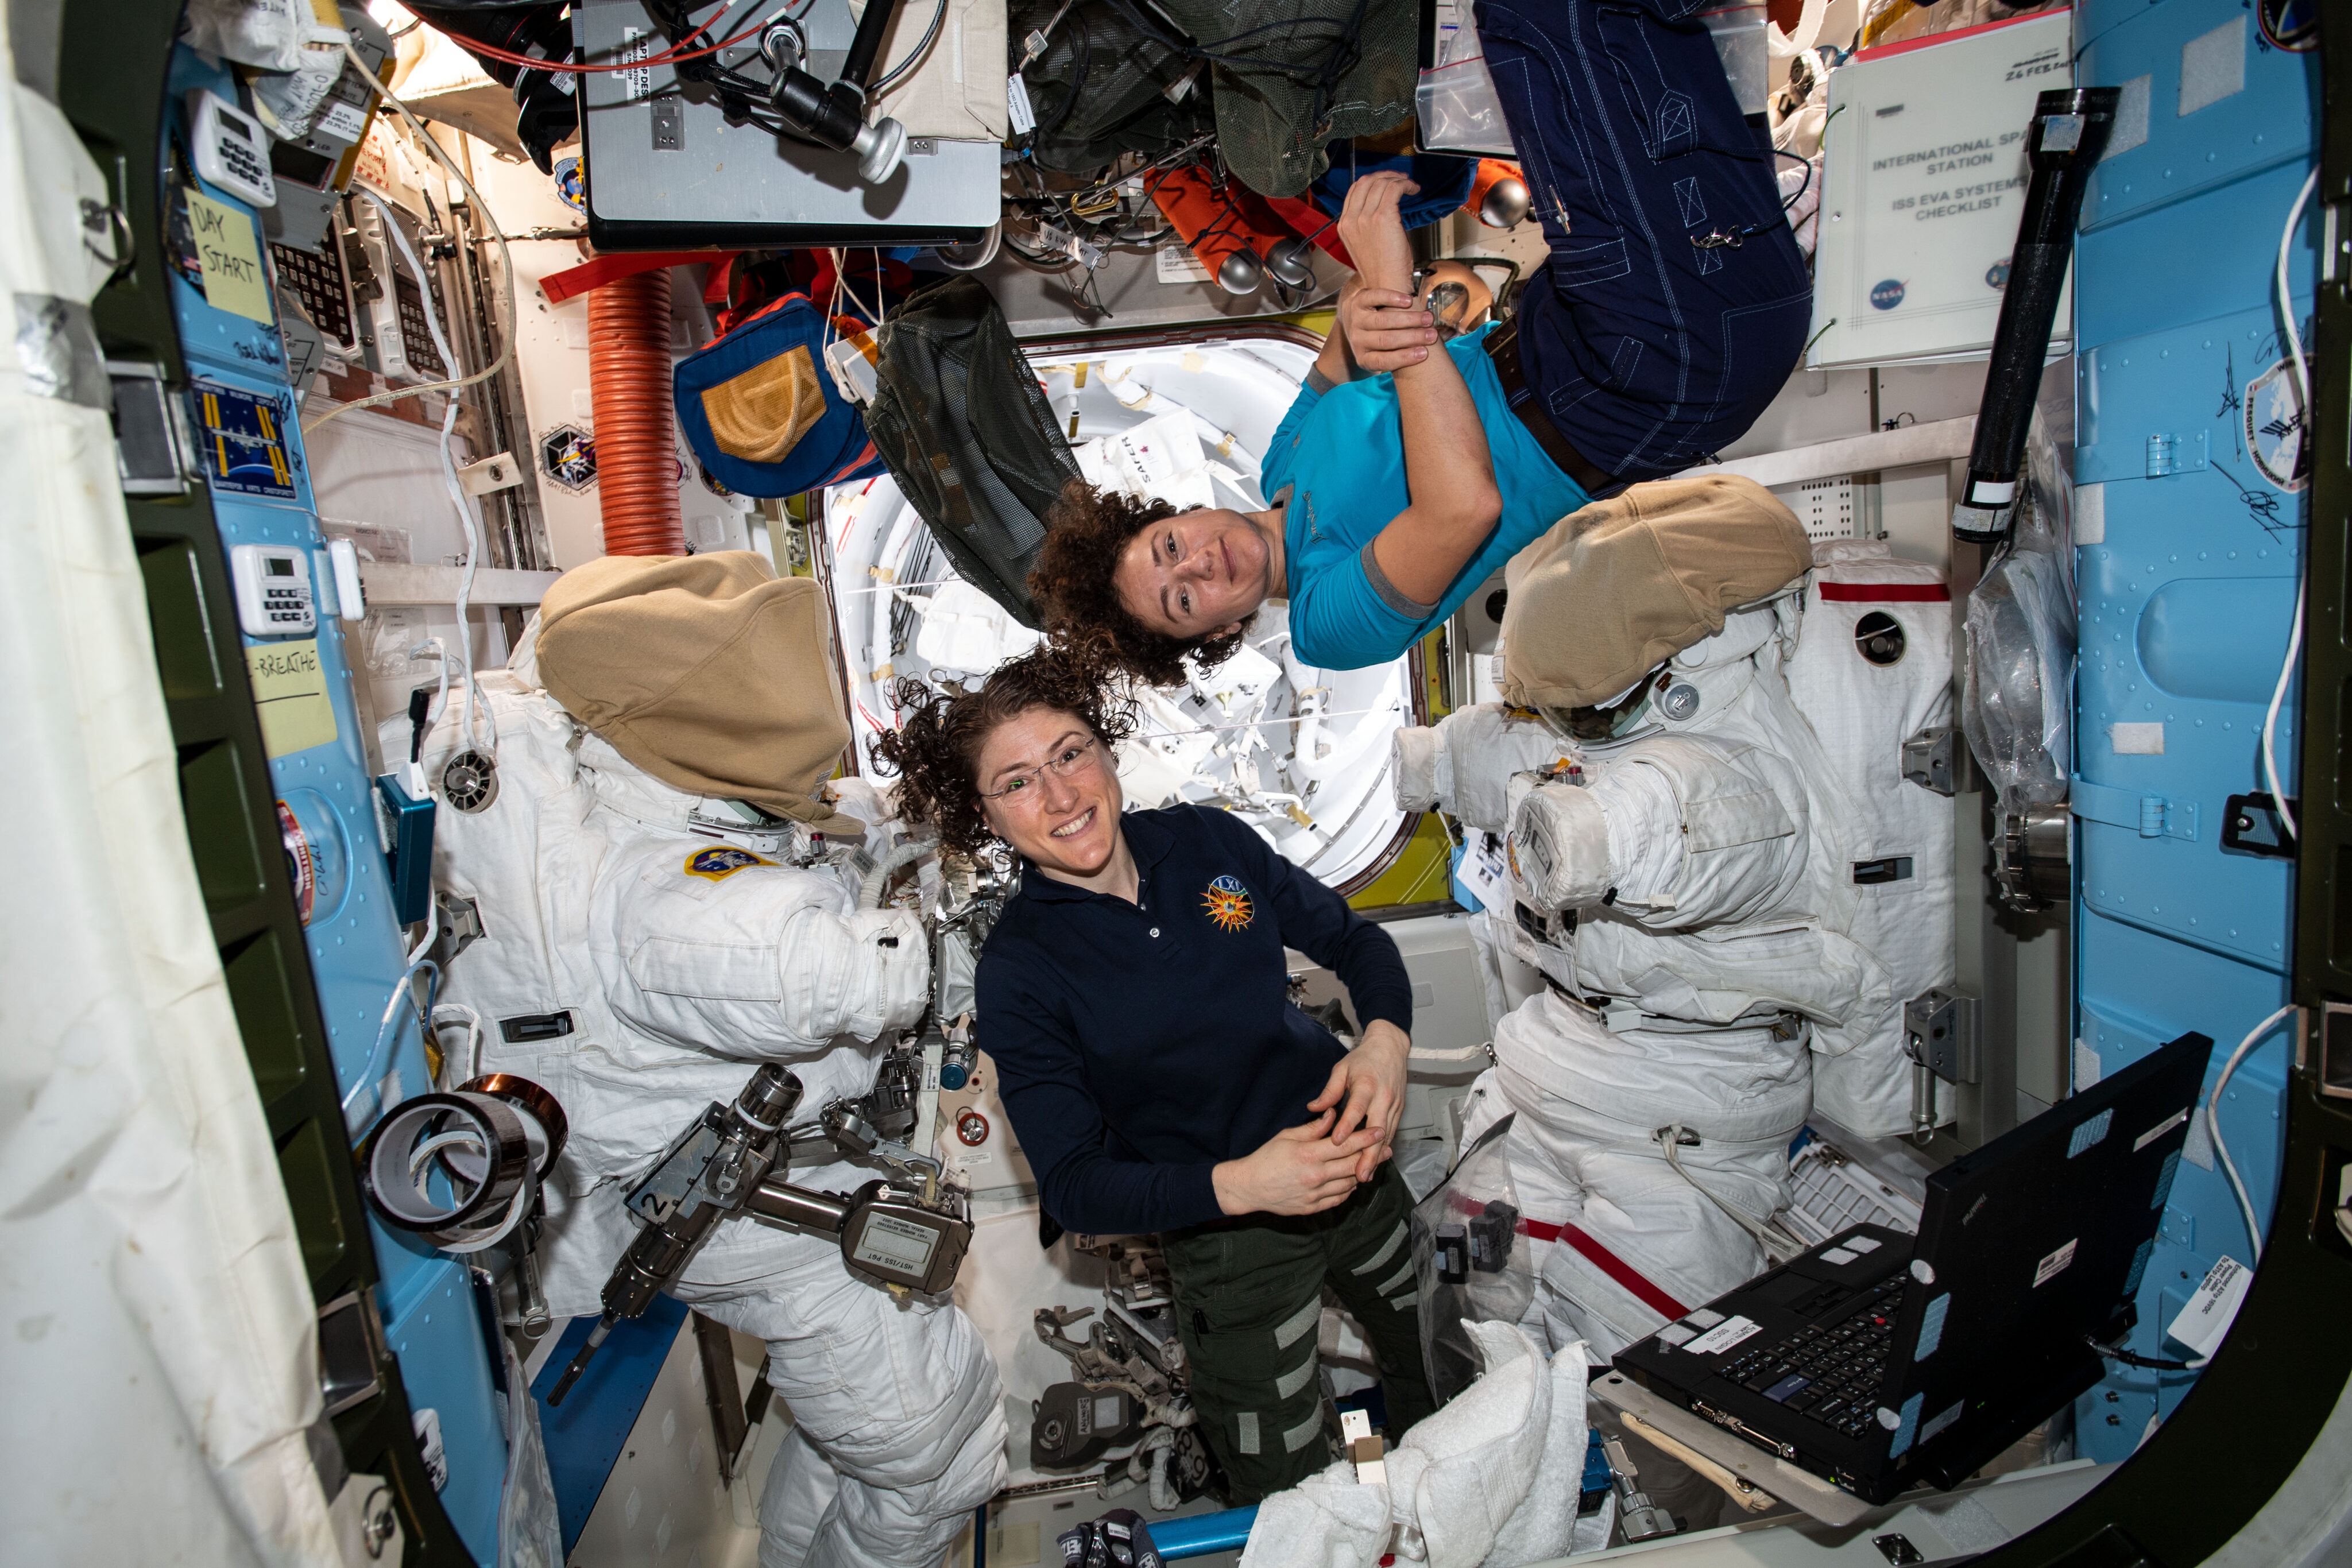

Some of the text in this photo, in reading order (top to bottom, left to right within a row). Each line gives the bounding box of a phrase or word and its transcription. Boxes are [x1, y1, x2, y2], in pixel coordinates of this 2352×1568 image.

[639, 36, 649, 102] LAPTP DESK
[2005, 71, 2023, 81] 26
[2027, 63, 2051, 77] FEB
[1873, 129, 2028, 171] INTERNATIONAL SPA
[1927, 152, 1994, 175] STATION
[1892, 175, 2028, 212] ISS EVA SYSTEMS
[193, 201, 225, 242] DAY
[1916, 196, 2002, 222] CHECKLIST
[203, 245, 254, 284] START
[2246, 397, 2254, 442] PESQUET
[1121, 436, 1151, 483] SAFER
[2252, 451, 2285, 487] НОВИЦКИЙ
[293, 832, 312, 890] WHITSON
[1218, 878, 1240, 891] LXI
[640, 1193, 668, 1217] 2
[1962, 1193, 1988, 1226] ThinkPad
[867, 1253, 914, 1271] HST/ISS PGT
[2212, 1263, 2224, 1275] A31p
[2200, 1275, 2216, 1291] Laptop
[2210, 1264, 2233, 1292] Power Cable
[2222, 1264, 2242, 1288] Enhanced
[2213, 1288, 2225, 1299] A31p
[1706, 1329, 1730, 1342] SSC10
[1715, 1338, 1736, 1352] LOGIN
[1735, 1326, 1757, 1339] ADMIN
